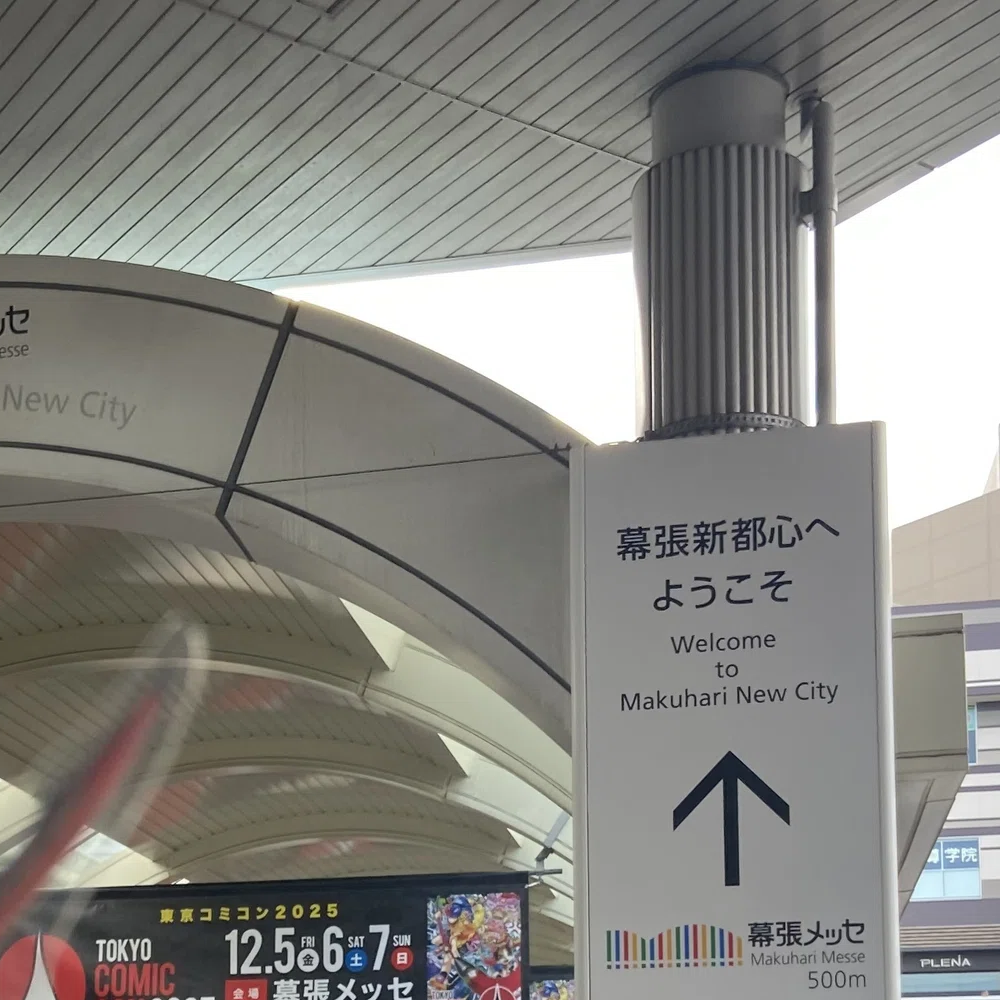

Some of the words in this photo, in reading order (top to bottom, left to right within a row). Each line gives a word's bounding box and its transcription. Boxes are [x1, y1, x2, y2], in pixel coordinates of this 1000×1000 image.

[3, 384, 69, 414] New
[80, 391, 137, 430] City
[617, 515, 839, 561] 幕張新都心へ
[653, 570, 793, 611] ようこそ
[670, 632, 776, 654] Welcome
[715, 661, 739, 678] to
[621, 687, 727, 711] Makuhari
[737, 686, 787, 704] New
[795, 681, 838, 704] City
[160, 903, 339, 923] 東京コミコン2025
[301, 936, 315, 948] FRI
[348, 935, 365, 948] SAT
[393, 934, 411, 946] SUN
[748, 919, 865, 947] 幕張メッセ
[96, 938, 152, 962] TOKYO
[225, 927, 296, 975] 12.5
[323, 925, 344, 973] 6
[369, 924, 390, 971] 7
[397, 951, 407, 964] 日
[751, 950, 817, 966] Makuhari
[822, 951, 865, 963] Messe
[302, 953, 315, 967] 金
[350, 953, 362, 966] 土
[920, 954, 971, 968] PLENA
[94, 962, 176, 998] COMIC
[808, 970, 866, 989] 500m
